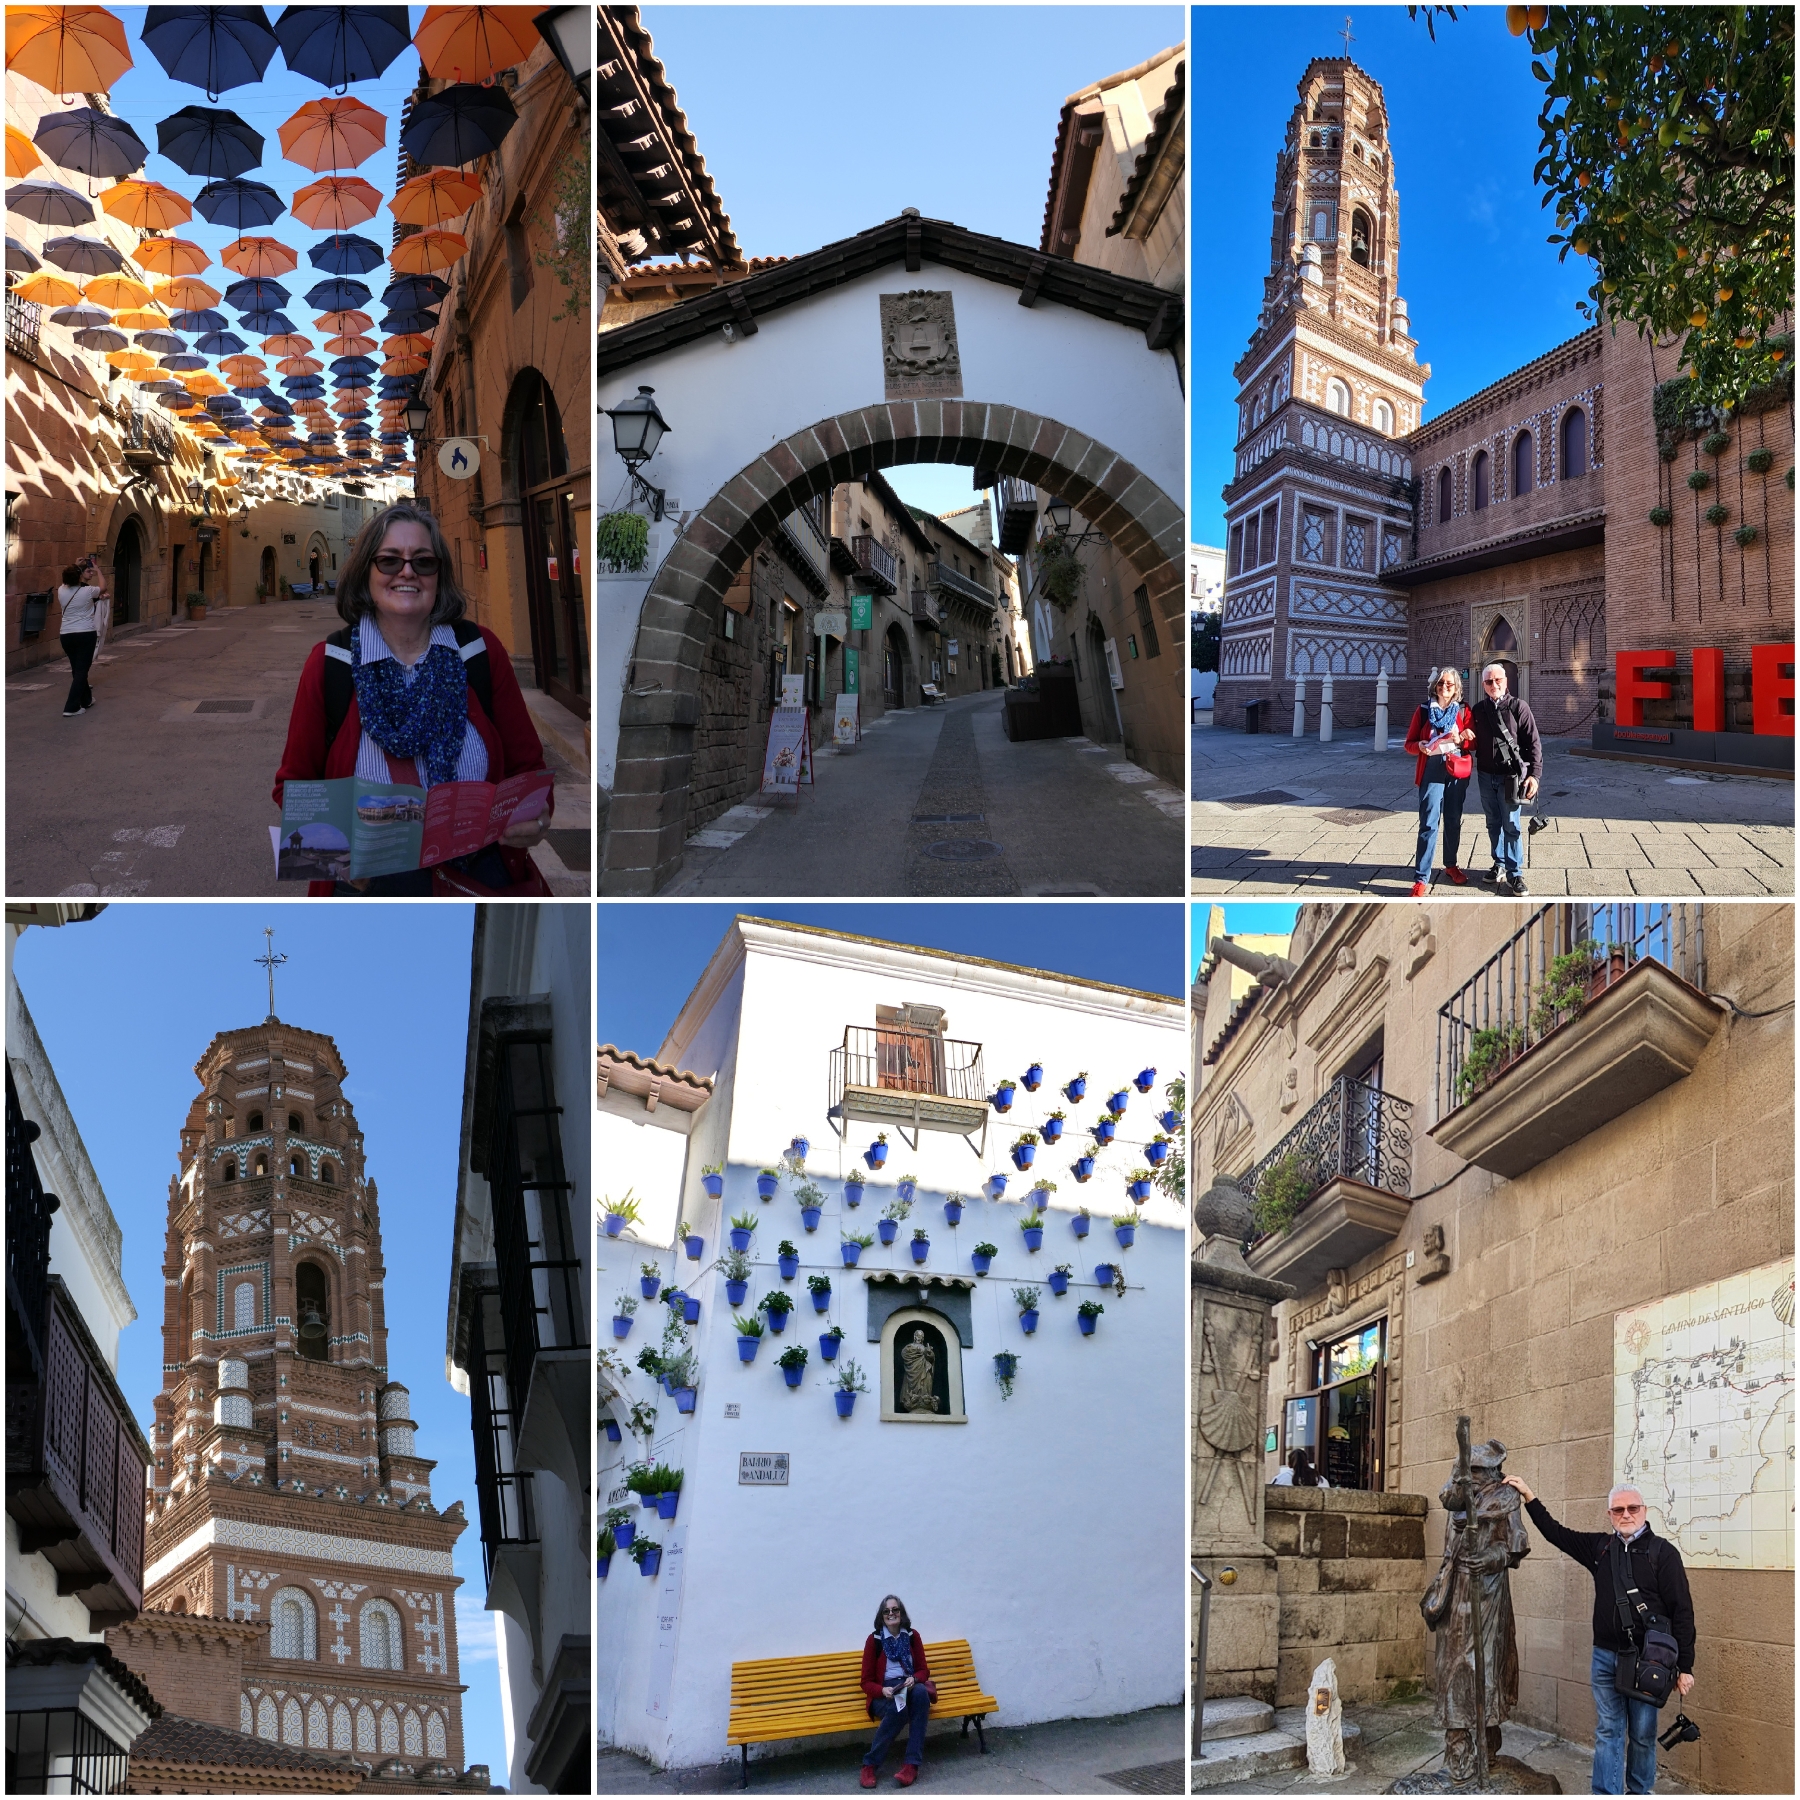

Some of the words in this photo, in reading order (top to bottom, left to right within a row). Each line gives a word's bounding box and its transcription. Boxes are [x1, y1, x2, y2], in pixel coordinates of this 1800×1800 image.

[1661, 1318, 1696, 1336] CAMINO
[1697, 1312, 1712, 1326] DE
[1712, 1298, 1765, 1322] SANTIAGO
[742, 1457, 772, 1468] BARRIO
[749, 1470, 786, 1481] ANDALUZ
